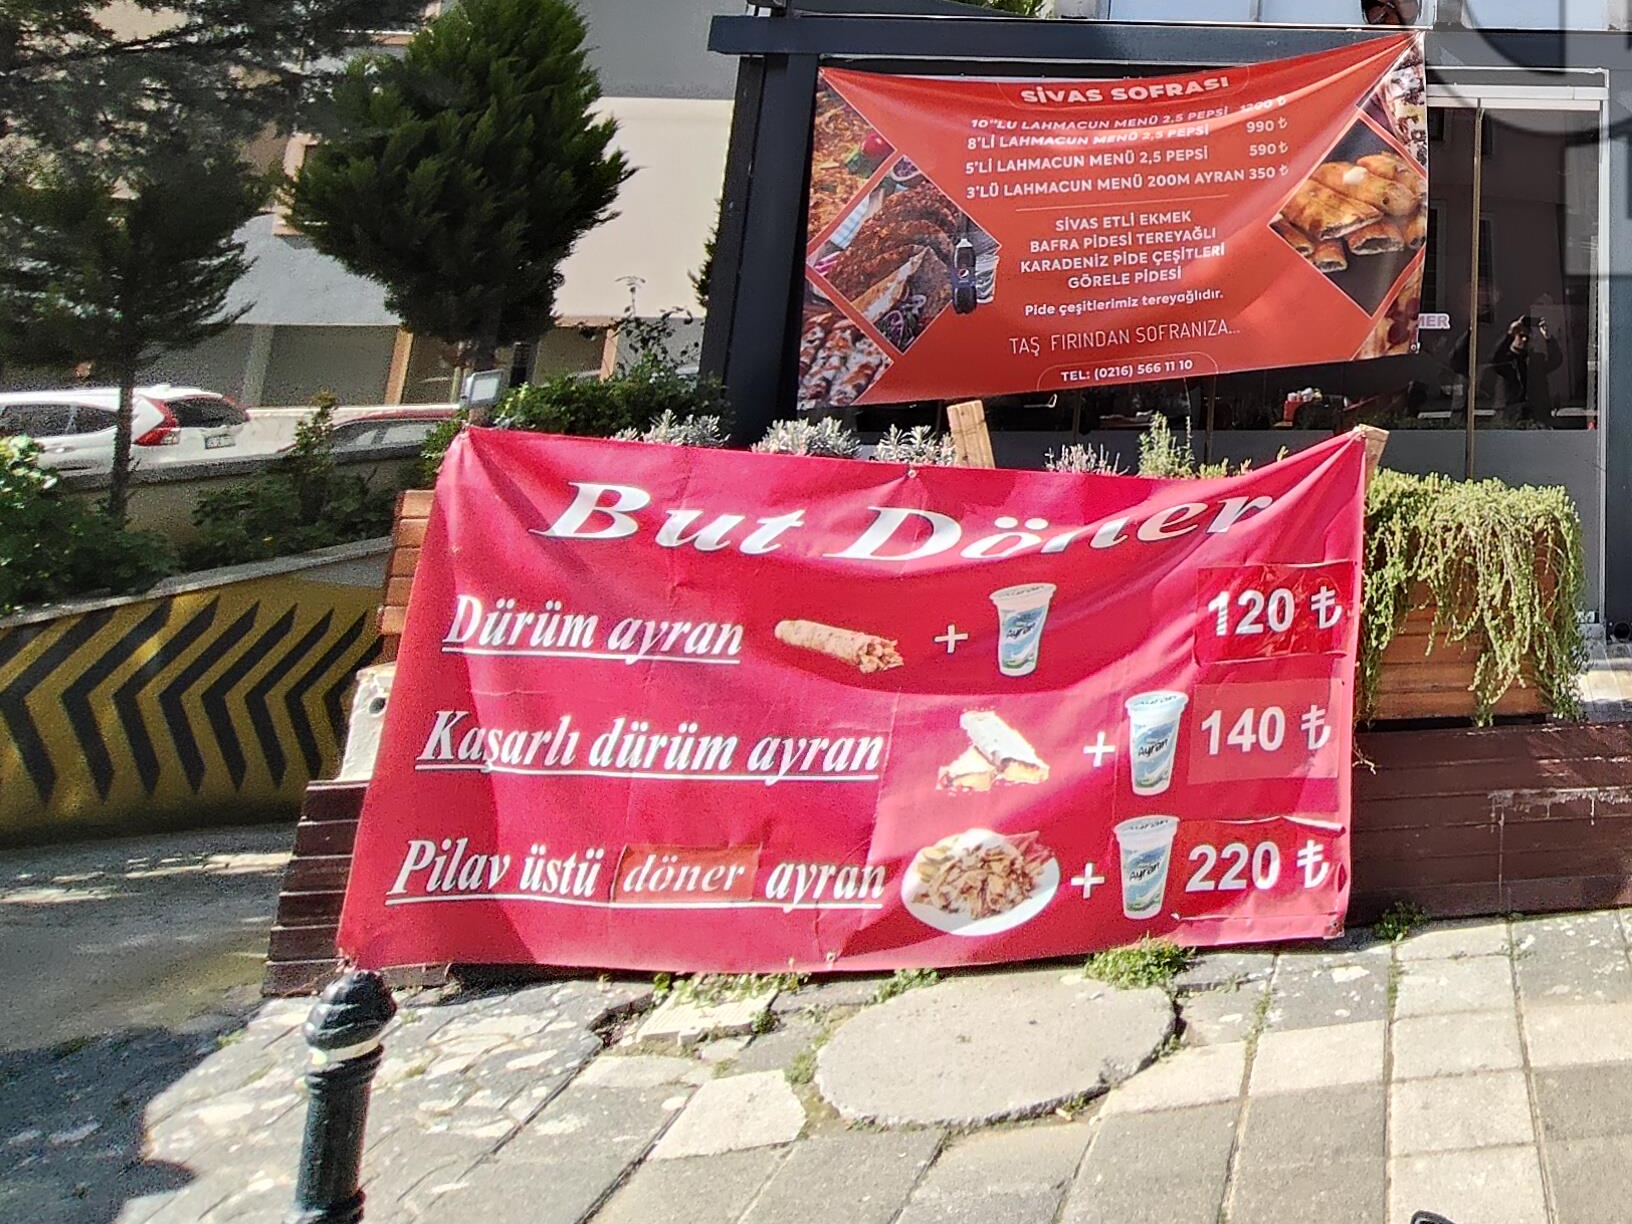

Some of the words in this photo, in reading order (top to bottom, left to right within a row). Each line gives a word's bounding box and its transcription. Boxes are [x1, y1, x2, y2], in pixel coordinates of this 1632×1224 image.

[1020, 85, 1103, 104] SİVAS
[1110, 76, 1230, 102] SOFRASI
[999, 134, 1089, 148] LAHMACUN
[1167, 123, 1209, 138] PEPSİ
[1246, 120, 1275, 133] 990
[1278, 116, 1288, 129] ₺
[1021, 119, 1110, 131] LAHMACUN
[965, 157, 993, 174] 5'Lİ
[996, 154, 1085, 172] LAHMACUN
[1089, 149, 1135, 167] MENÜ
[1166, 145, 1209, 162] PEPSİ
[1248, 143, 1277, 157] 590
[1279, 141, 1289, 154] ₺
[966, 180, 1000, 200] 3'LÜ
[1003, 178, 1093, 197] LAHMACUN
[1097, 173, 1143, 191] MENÜ
[1147, 173, 1191, 188] 200M
[1194, 169, 1245, 185] AYRAN
[1248, 166, 1276, 180] 350
[1279, 164, 1289, 177] ₺
[1055, 216, 1099, 232] SİVAS
[1103, 212, 1135, 228] ETLİ
[1139, 210, 1192, 226] EKMEK
[1030, 238, 1080, 253] BAFRA
[1083, 231, 1133, 250] PİDESİ
[1136, 226, 1216, 246] TEREYAĞLI
[1020, 254, 1109, 273] KARADENİZ
[1113, 249, 1148, 265] PİDE
[1152, 242, 1226, 264] ÇEŞİTLERİ
[1067, 272, 1130, 289] GÖRELE
[1134, 265, 1182, 284] PİDESİ
[1025, 304, 1056, 317] Pide
[1059, 295, 1139, 318] çeşitlerimiz
[1142, 289, 1224, 310] tereyağlıdır.
[1009, 336, 1041, 357] TAŞ
[1050, 329, 1131, 352] FIRINDAN
[1135, 318, 1241, 344] SOFRANIZA...
[1061, 370, 1091, 383] TEL:
[1094, 364, 1134, 381] (0216)
[1137, 363, 1161, 374] 566
[1165, 361, 1176, 373] 11
[1178, 359, 1193, 371] 10
[528, 481, 805, 555] But
[822, 495, 1273, 562] Döner
[1207, 587, 1294, 636] 120
[1311, 585, 1343, 629] ₺
[442, 594, 599, 649] Dürüm
[607, 616, 744, 664] ayran
[1201, 706, 1286, 755] 140
[1301, 704, 1332, 751] ₺
[418, 710, 580, 774] Kaşarlı
[588, 716, 739, 770] dürüm
[747, 733, 884, 786] ayran
[1138, 738, 1168, 757] Ayran
[385, 837, 511, 897] Pilav
[519, 843, 605, 897] üstü
[622, 853, 745, 894] döner
[765, 860, 887, 913] ayran
[1185, 840, 1281, 893] 220
[1297, 839, 1330, 889] ₺
